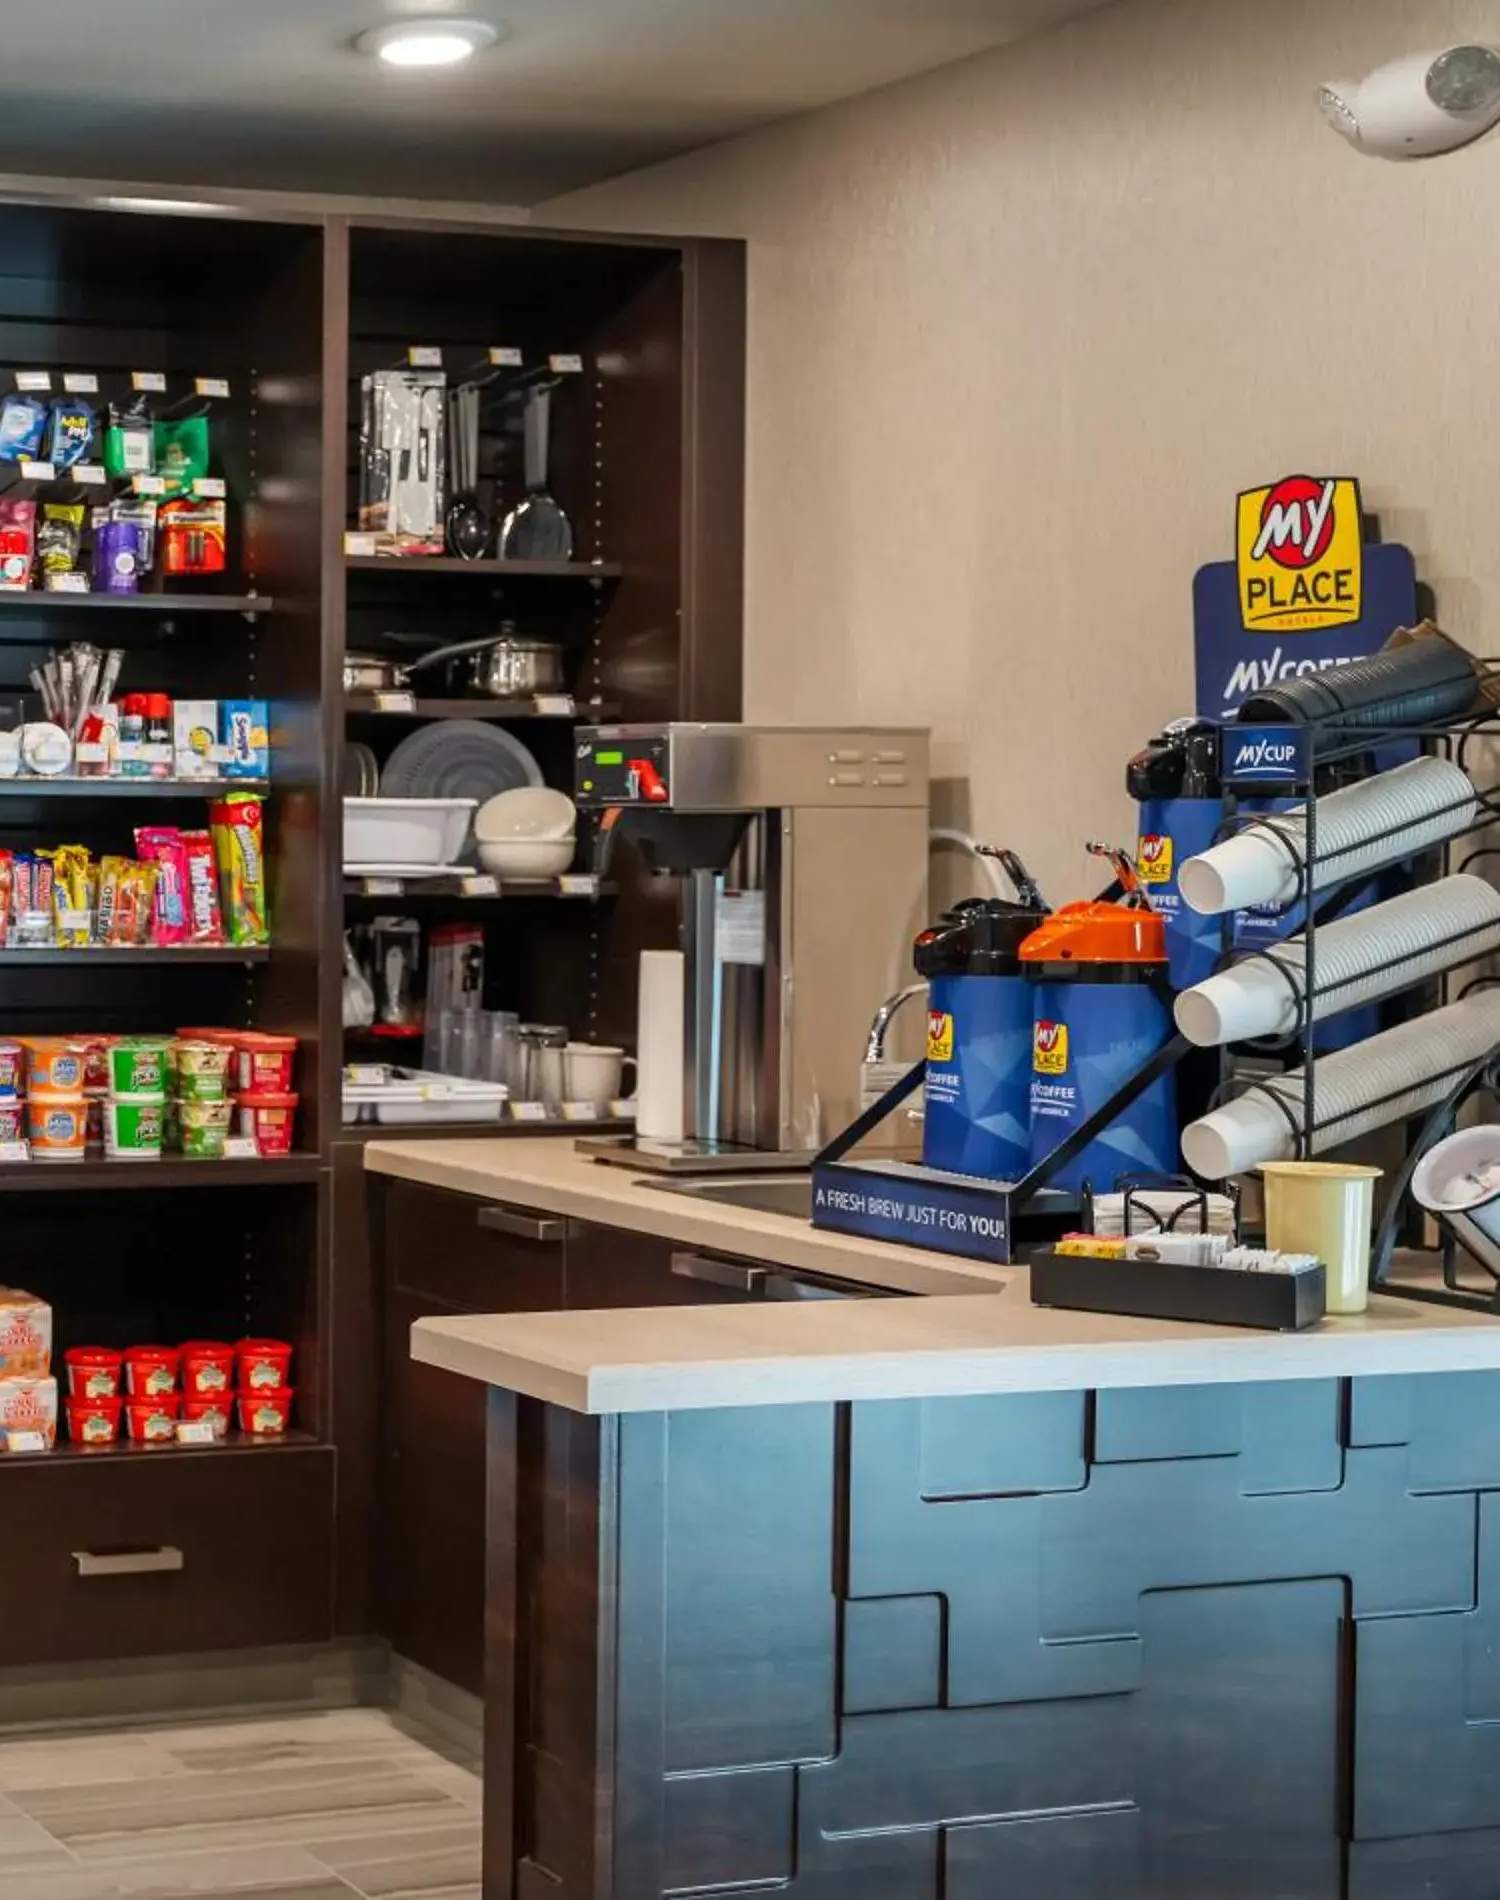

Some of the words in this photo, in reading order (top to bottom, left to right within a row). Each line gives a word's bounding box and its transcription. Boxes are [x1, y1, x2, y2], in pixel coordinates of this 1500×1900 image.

[1251, 479, 1336, 561] MY
[1247, 569, 1354, 609] PLACE
[1235, 740, 1296, 766] MYCUP
[815, 1188, 825, 1205] A
[827, 1189, 866, 1213] FRESH
[868, 1197, 903, 1219] BREW
[905, 1204, 937, 1226] JUST
[939, 1209, 967, 1232] FOR
[969, 1215, 1005, 1240] YOU!
